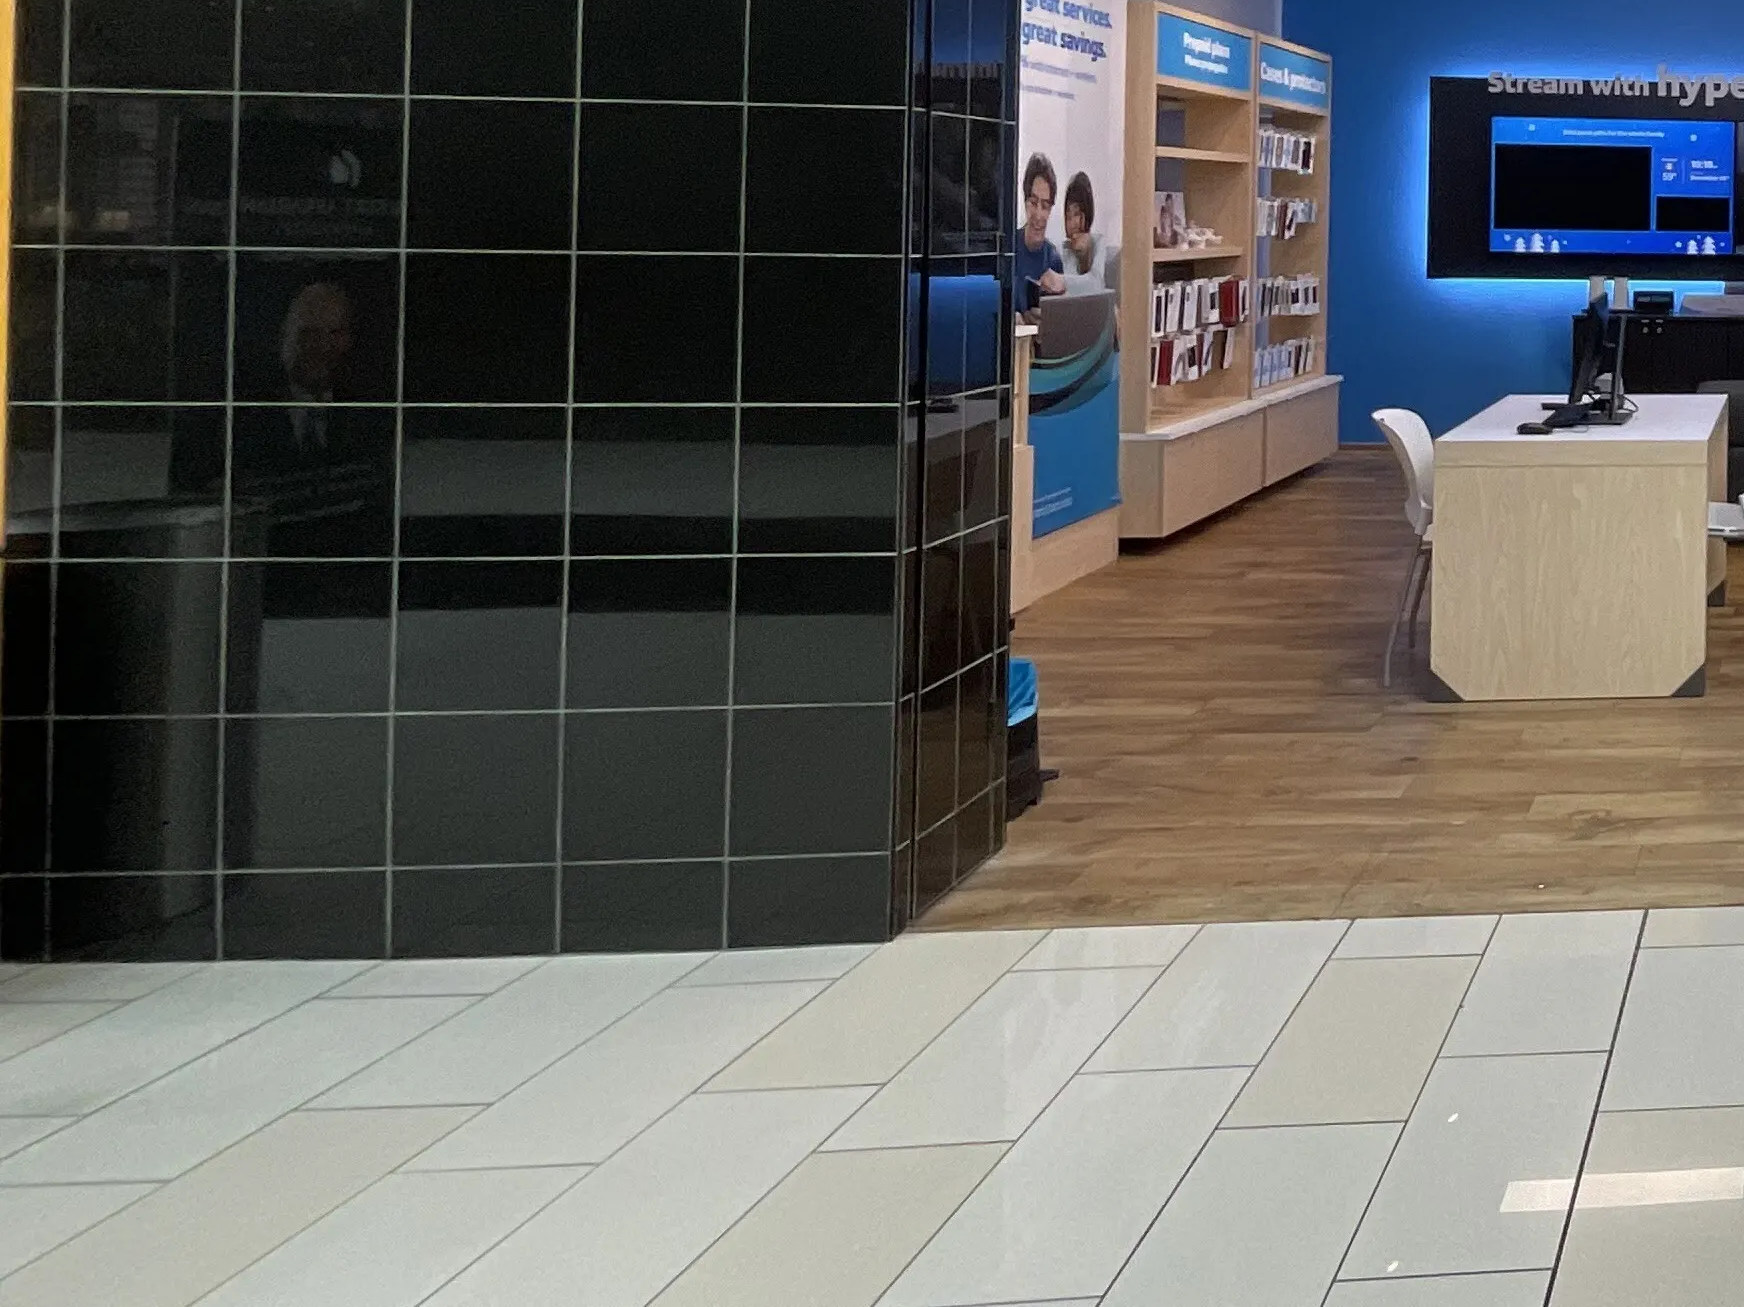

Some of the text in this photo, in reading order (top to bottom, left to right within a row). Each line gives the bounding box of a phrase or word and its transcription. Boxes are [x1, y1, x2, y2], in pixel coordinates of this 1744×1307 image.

[1022, 21, 1057, 46] great
[1487, 71, 1584, 96] Stream
[1590, 73, 1651, 98] with
